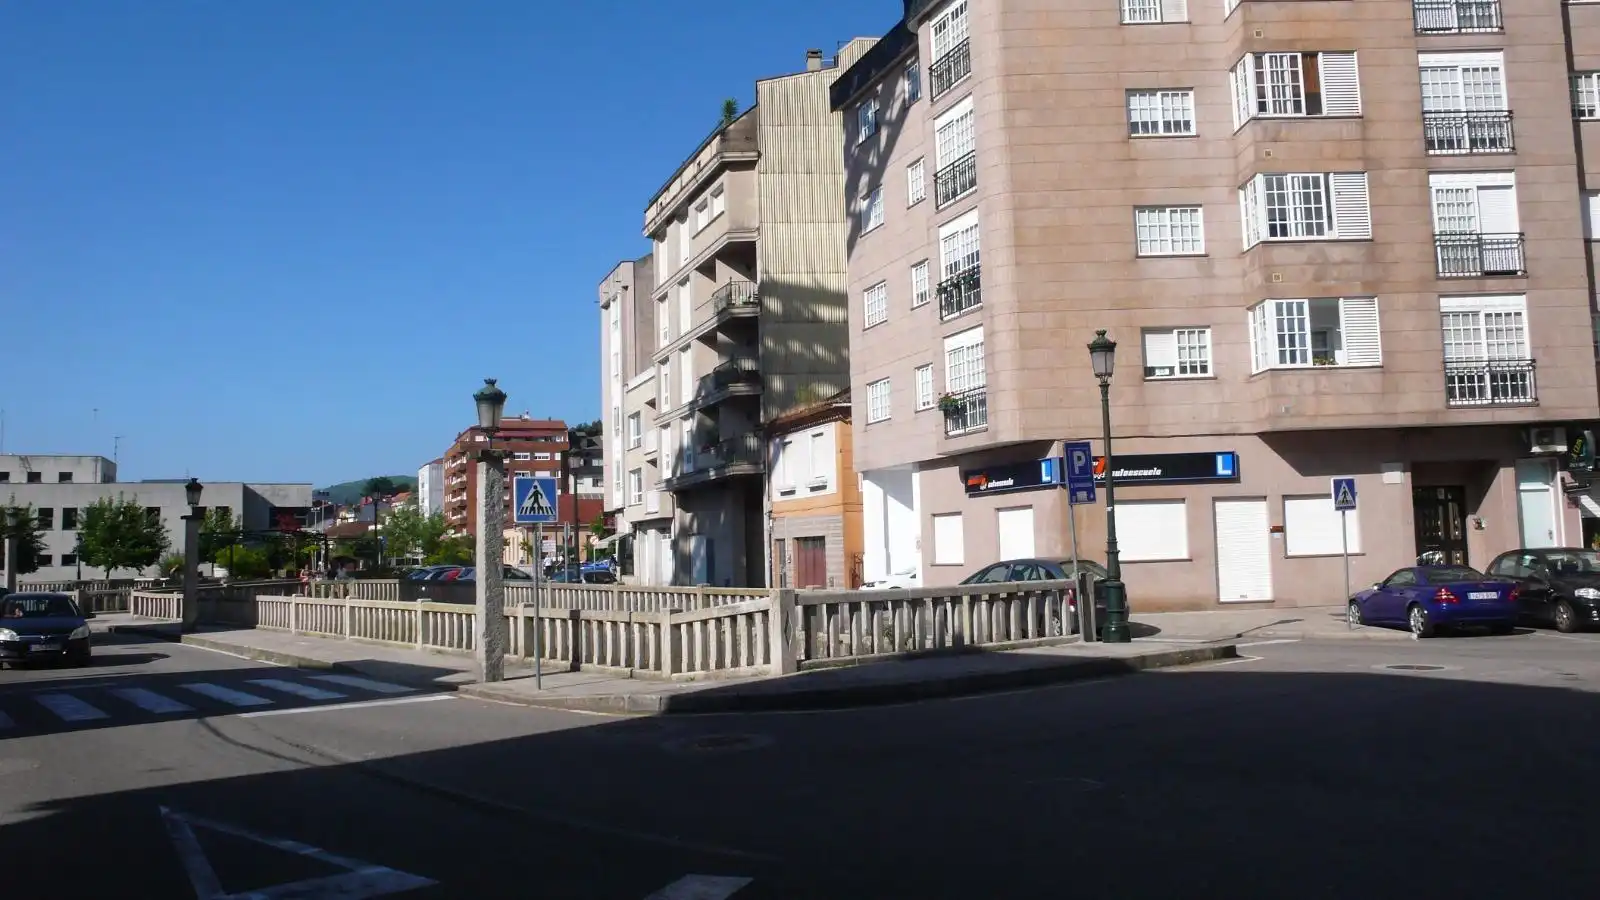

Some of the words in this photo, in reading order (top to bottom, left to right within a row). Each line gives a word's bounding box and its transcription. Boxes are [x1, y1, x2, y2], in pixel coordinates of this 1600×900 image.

[1041, 462, 1051, 483] L
[1073, 451, 1086, 475] P
[1216, 455, 1232, 475] L
